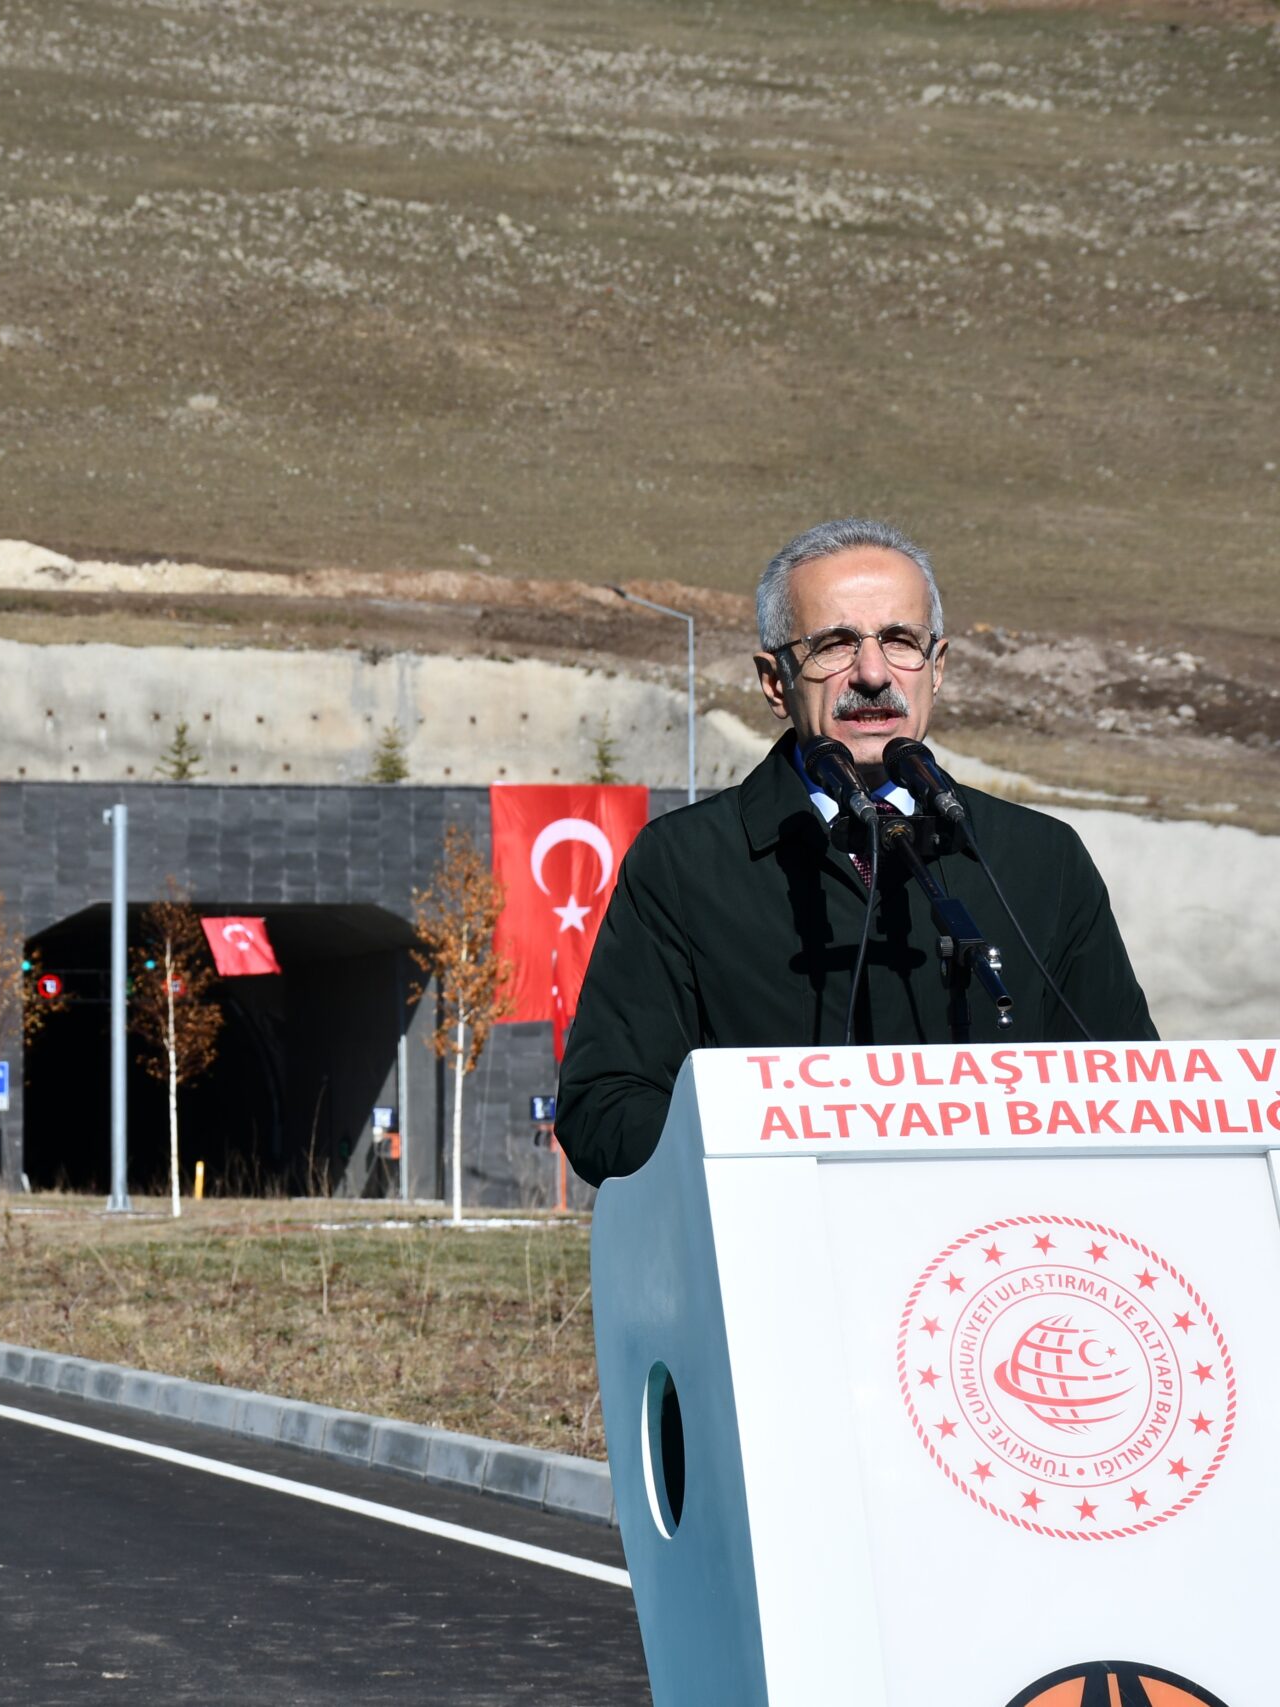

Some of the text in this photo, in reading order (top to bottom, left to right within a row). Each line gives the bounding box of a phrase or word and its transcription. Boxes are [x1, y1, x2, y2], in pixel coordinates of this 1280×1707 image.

[747, 1053, 851, 1089] T.C.
[866, 1049, 1223, 1095] ULAŞTIRMA
[760, 1101, 991, 1140] ALTYAPI
[959, 1273, 1174, 1478] TÜRKİYE CUMHURİYETİ ULAŞTIRMA VE ALTYAPI BAKANLIĞI
